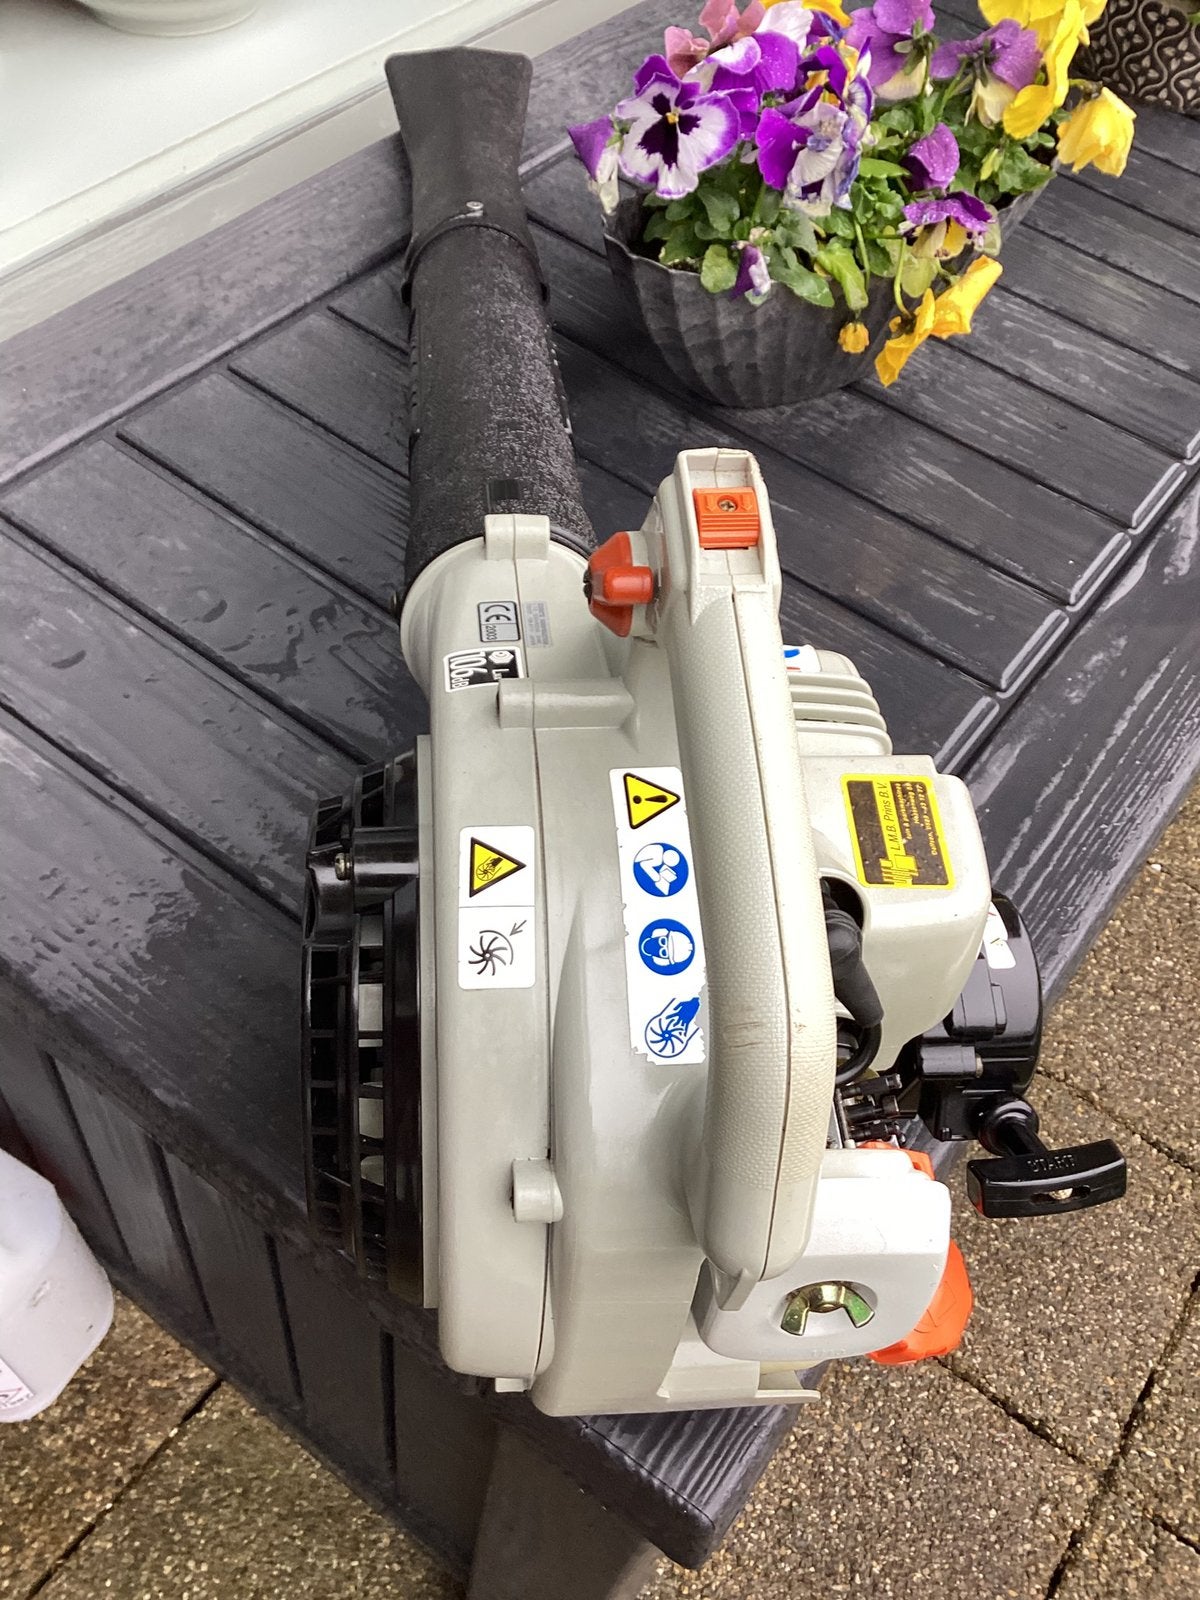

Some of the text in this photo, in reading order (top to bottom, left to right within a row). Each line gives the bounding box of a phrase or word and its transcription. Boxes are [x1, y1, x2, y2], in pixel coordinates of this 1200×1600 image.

[484, 604, 512, 622] CE
[485, 624, 497, 640] 2003
[877, 782, 900, 850] L.M.B. Prins B.V.
